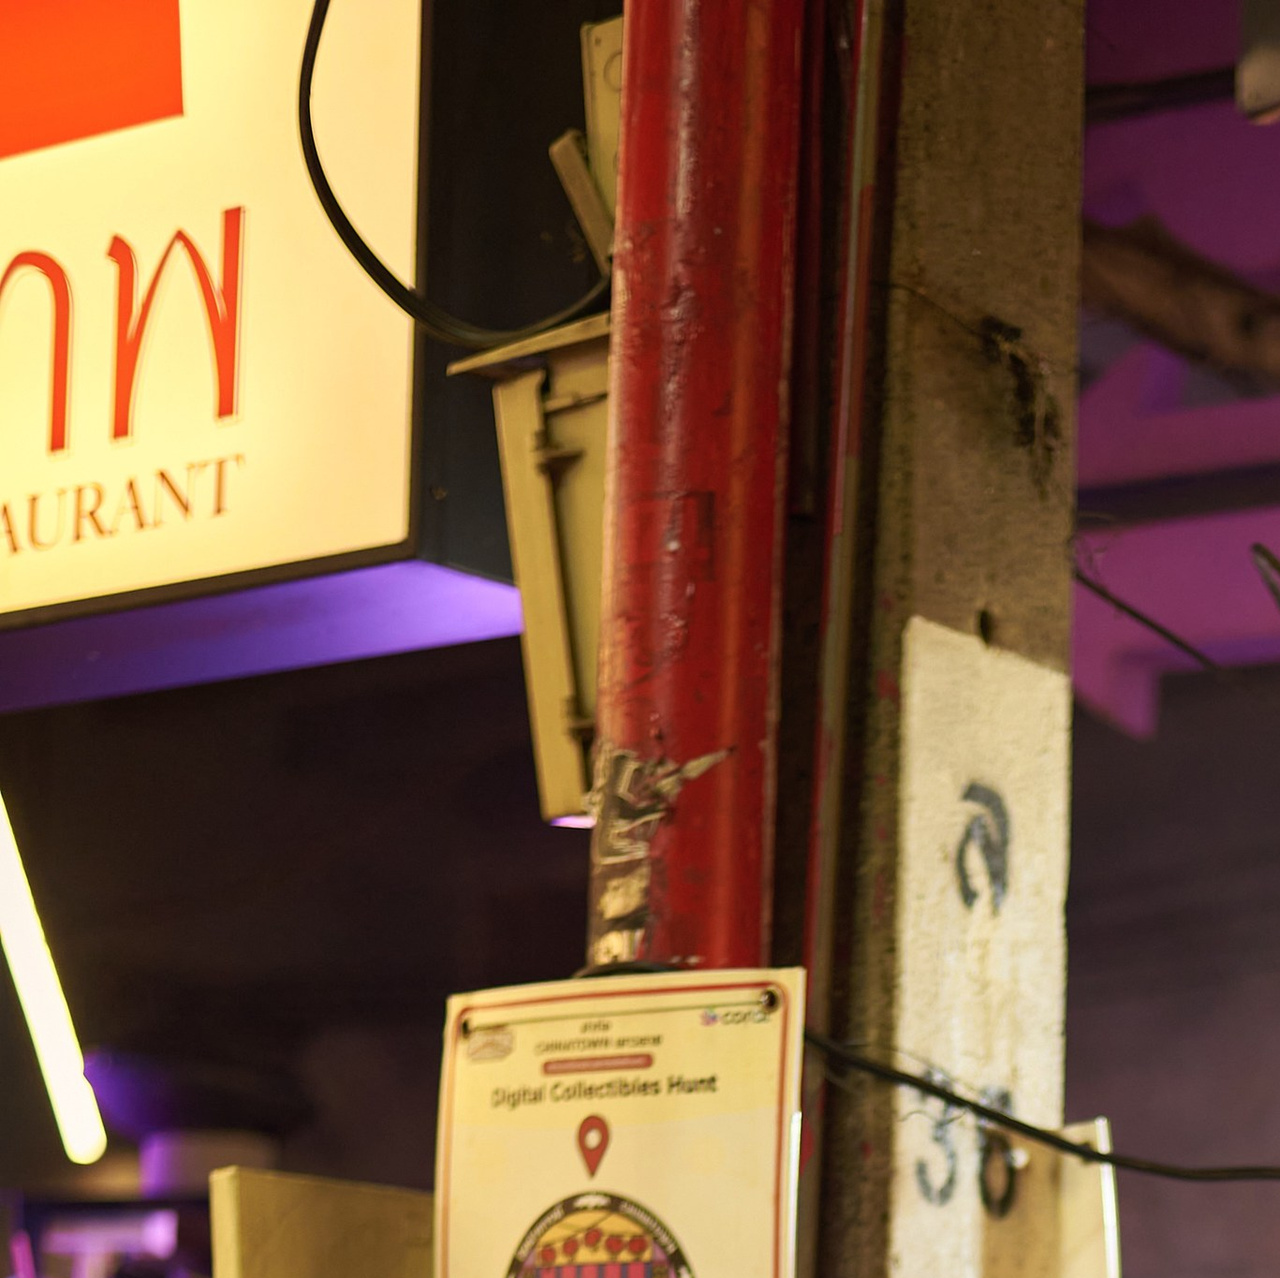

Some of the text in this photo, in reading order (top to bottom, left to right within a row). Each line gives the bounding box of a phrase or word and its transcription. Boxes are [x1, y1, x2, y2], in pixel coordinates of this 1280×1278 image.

[492, 1073, 718, 1110] Digital Collectibles Hunt
